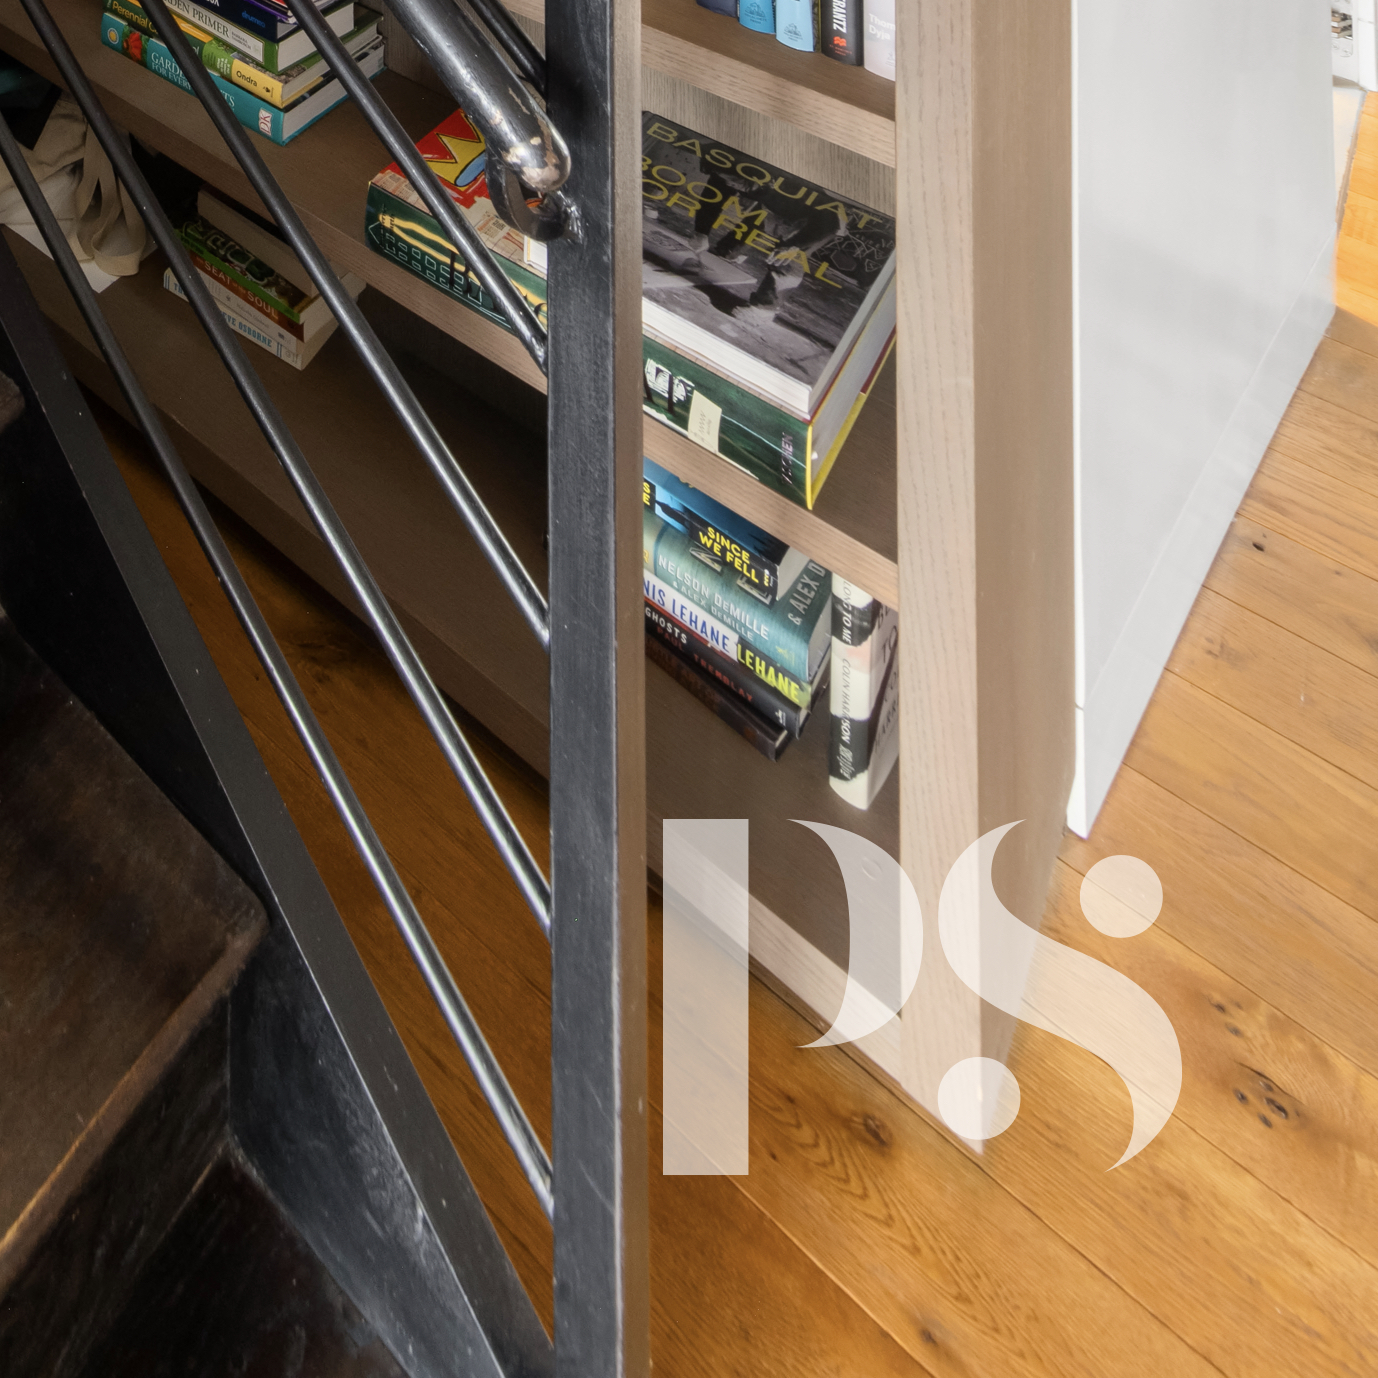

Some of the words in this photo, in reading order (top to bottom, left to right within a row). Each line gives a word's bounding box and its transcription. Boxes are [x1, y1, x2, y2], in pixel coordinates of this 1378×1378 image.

[112, 0, 148, 29] Perennial
[235, 69, 259, 88] Ondra
[259, 112, 273, 136] DK
[646, 122, 883, 230] BASQUIAT
[642, 178, 702, 218] OR
[712, 212, 843, 290] REAL
[204, 260, 231, 285] SEAT
[247, 290, 279, 321] SOUL
[698, 530, 722, 557] WE
[725, 550, 760, 584] FELL
[707, 525, 751, 565] SINCE
[658, 554, 710, 600] NELSON
[714, 592, 770, 642] DEMILLE
[645, 607, 689, 645] GHOSTS
[736, 643, 801, 704] LEHANE
[841, 657, 852, 689] COLIN
[840, 689, 852, 745] HARRISON
